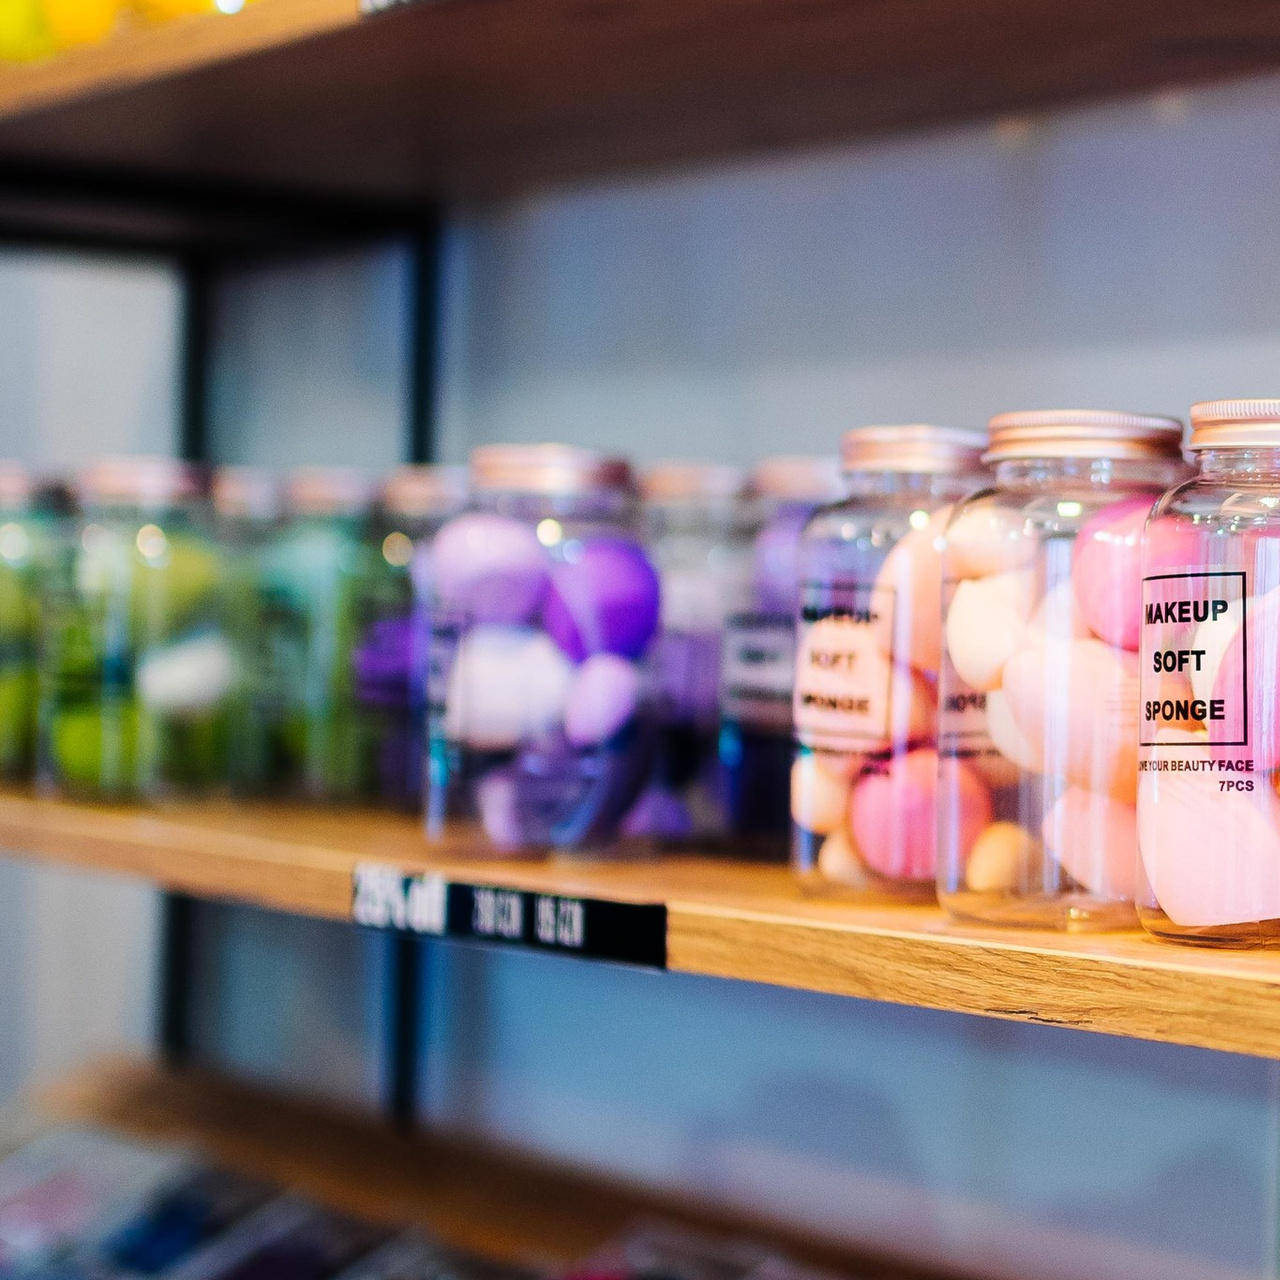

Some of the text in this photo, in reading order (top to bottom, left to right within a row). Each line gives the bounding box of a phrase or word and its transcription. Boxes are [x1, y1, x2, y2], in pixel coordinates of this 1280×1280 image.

[1145, 599, 1229, 626] MAKEUP
[1153, 649, 1206, 673] SOFT
[1145, 699, 1226, 721] SPONGE
[1170, 759, 1216, 772] BEAUTY
[1217, 759, 1255, 772] FACE
[1218, 780, 1255, 792] 7PCS
